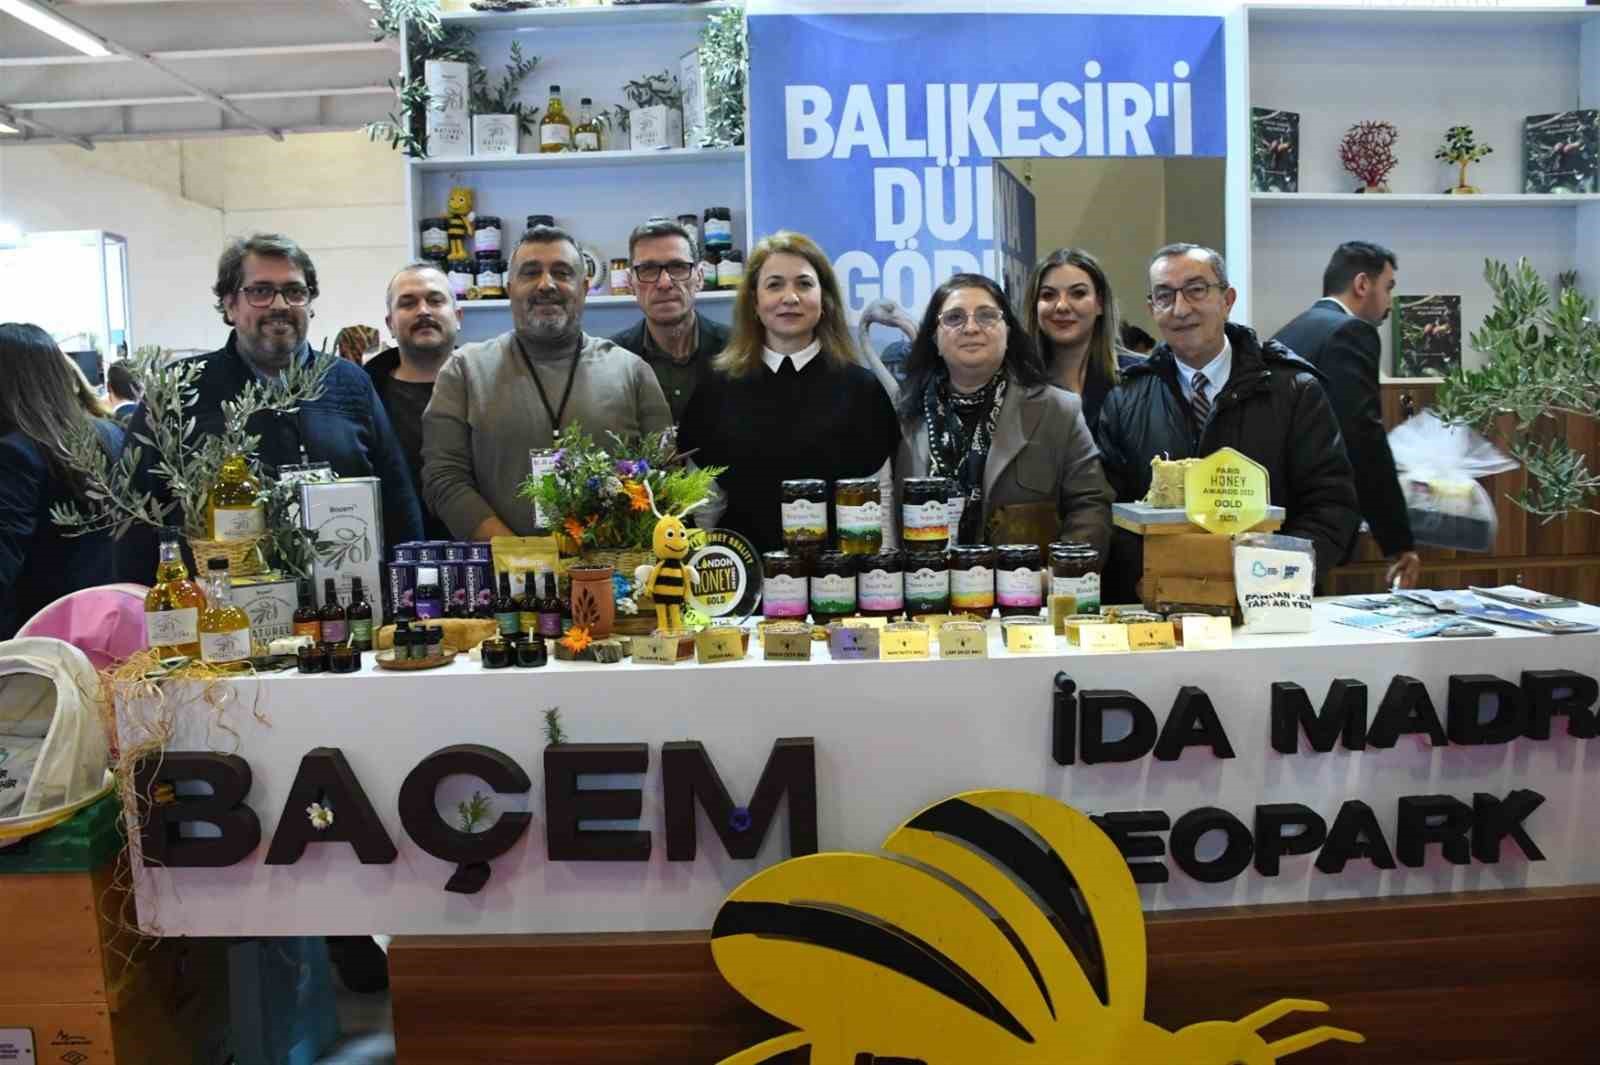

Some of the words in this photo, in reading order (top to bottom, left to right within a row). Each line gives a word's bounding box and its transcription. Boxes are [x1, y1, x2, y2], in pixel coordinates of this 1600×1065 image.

[785, 60, 1193, 160] BALIKESİR'İ
[1210, 475, 1247, 488] HONEY
[1214, 499, 1242, 508] GOLD
[695, 557, 734, 569] LONDON
[250, 624, 291, 639] ATUREL
[1052, 671, 1236, 766] İDA
[1271, 669, 1600, 754] MADR
[141, 737, 819, 894] BAÇEM
[1089, 789, 1547, 884] EOPARK
